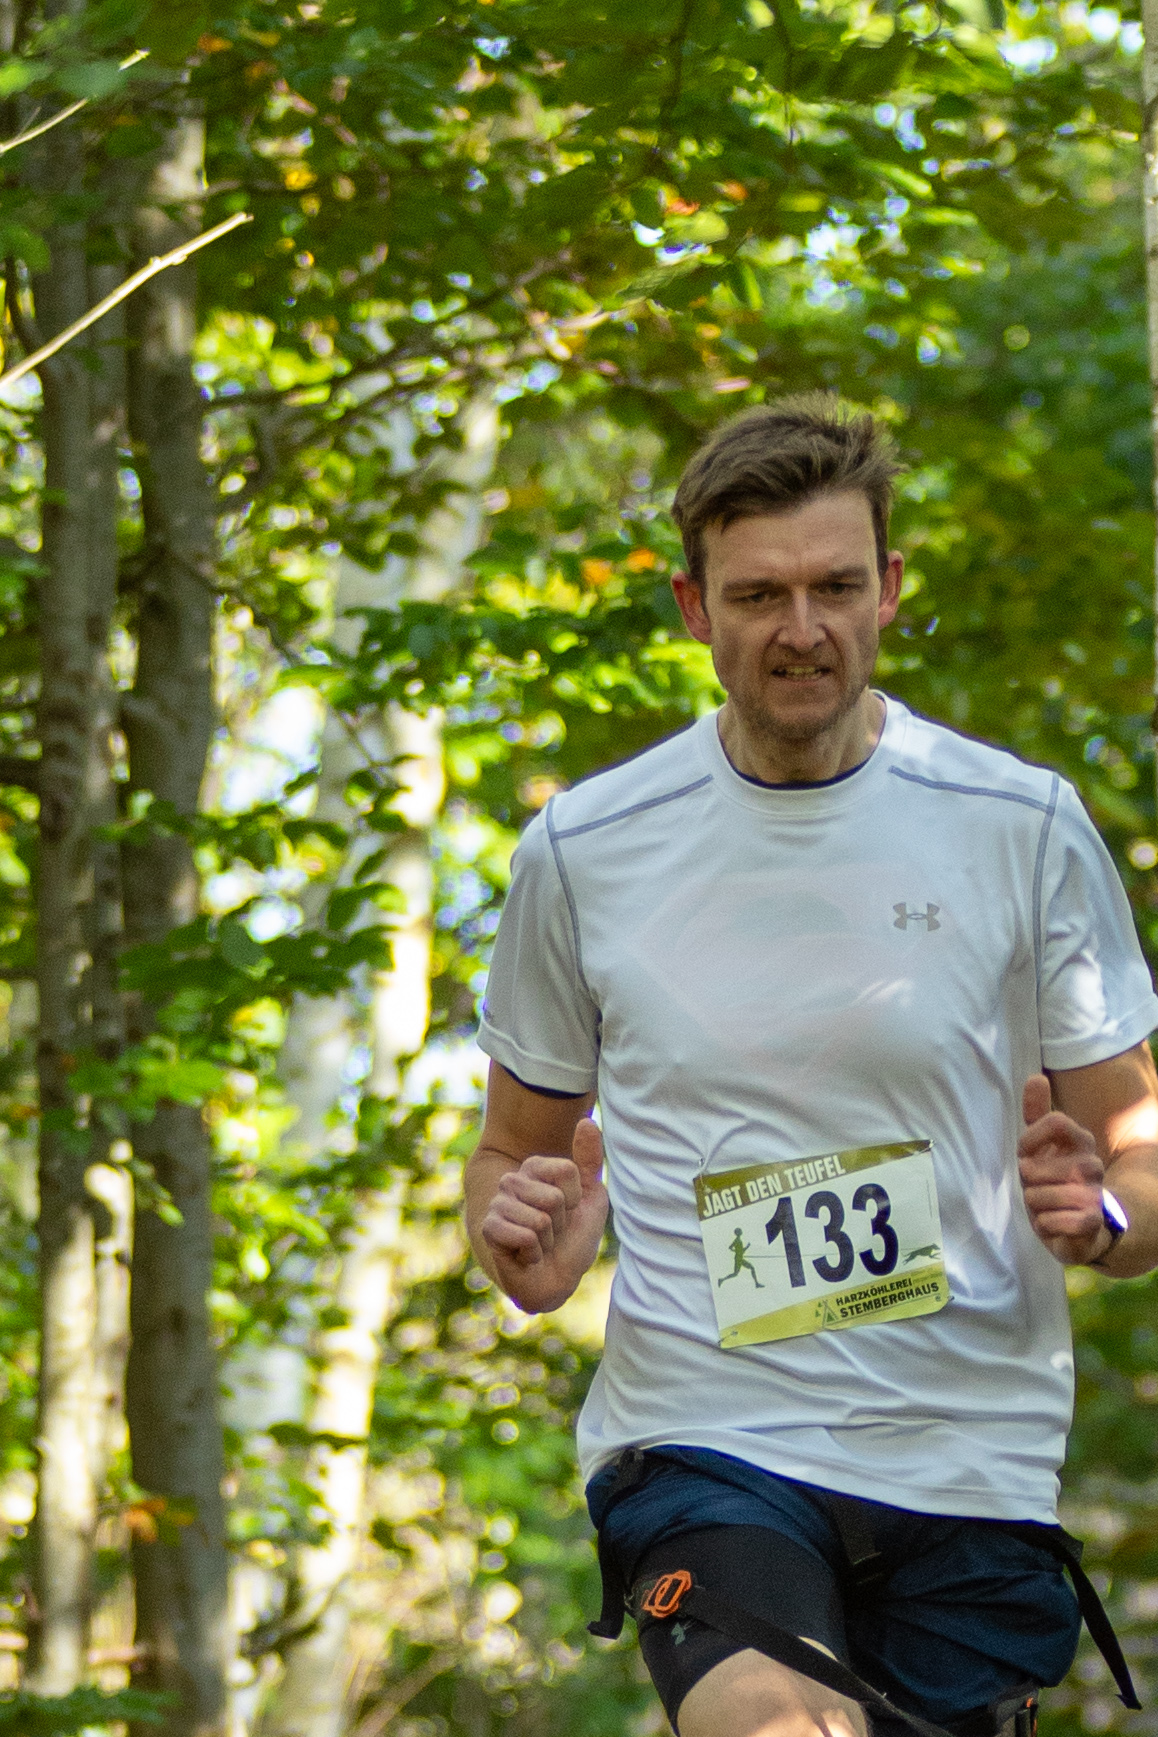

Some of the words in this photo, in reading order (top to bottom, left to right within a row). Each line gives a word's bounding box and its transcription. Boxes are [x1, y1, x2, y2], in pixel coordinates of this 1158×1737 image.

[703, 1185, 743, 1218] JAGT
[745, 1173, 783, 1203] DEN
[784, 1155, 846, 1189] TEUFEL
[765, 1183, 898, 1288] 133
[836, 1278, 913, 1306] HARZKÖHLEREI
[840, 1282, 939, 1318] STEMBERGHAUS
